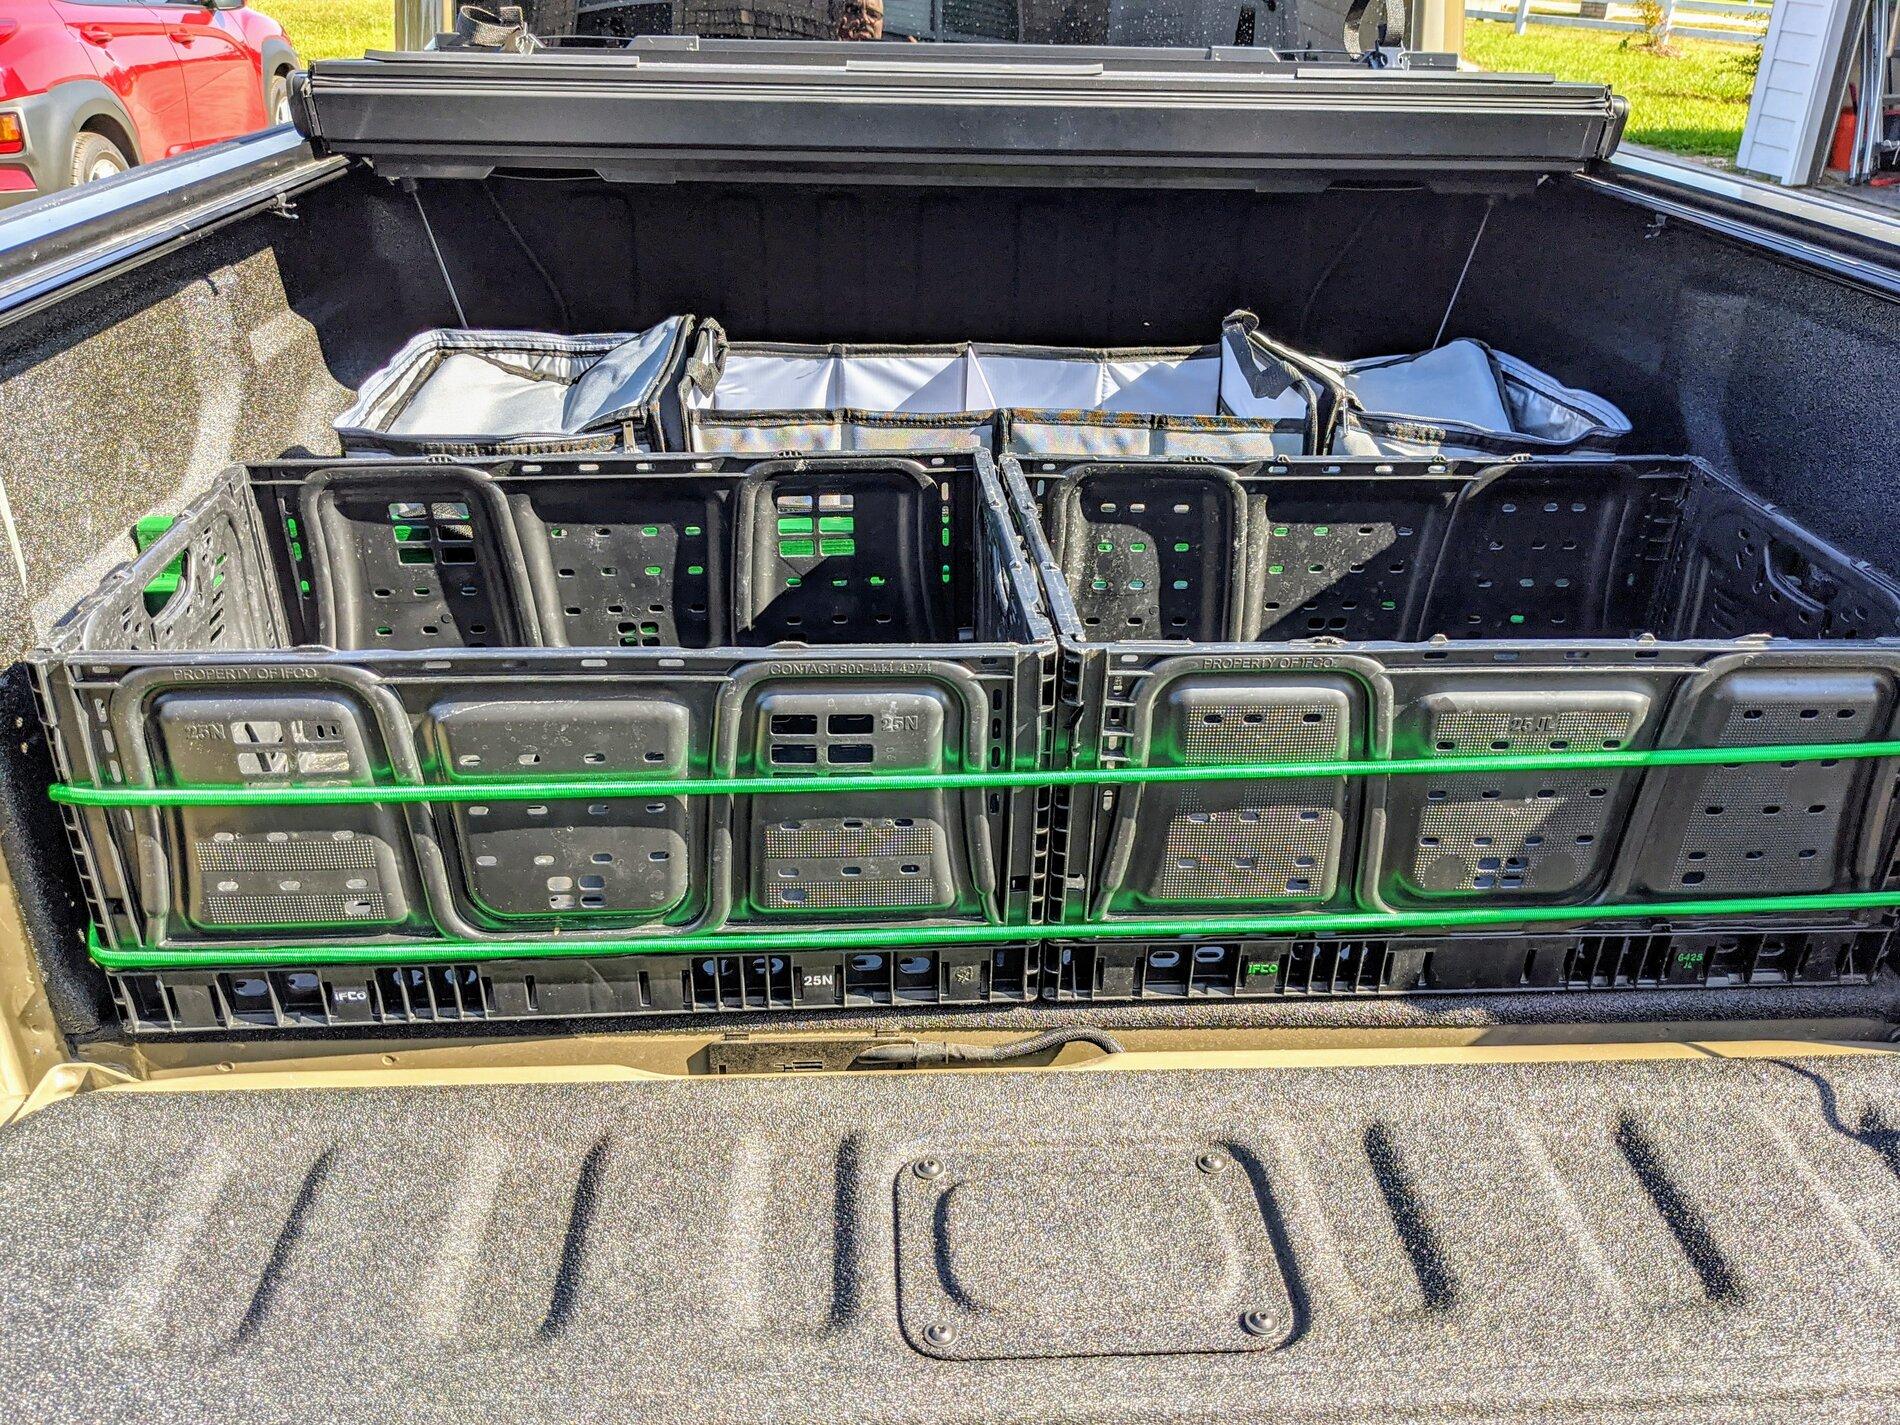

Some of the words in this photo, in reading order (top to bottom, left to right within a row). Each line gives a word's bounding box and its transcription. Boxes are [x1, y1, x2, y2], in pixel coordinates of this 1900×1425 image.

[769, 662, 837, 676] CONTACT
[1203, 656, 1277, 669] PROPERTY
[1280, 656, 1299, 668] OF
[1301, 656, 1334, 668] IFCO
[172, 666, 252, 681] PROPERTY
[256, 667, 278, 680] OF
[281, 667, 318, 680] IFCO
[880, 714, 919, 732] 25N
[1510, 716, 1534, 732] 25
[1535, 715, 1556, 732] JL
[184, 721, 227, 741] 25N
[1247, 963, 1279, 975] IFCO
[803, 973, 833, 987] 25N
[333, 989, 368, 1001] IFCO
